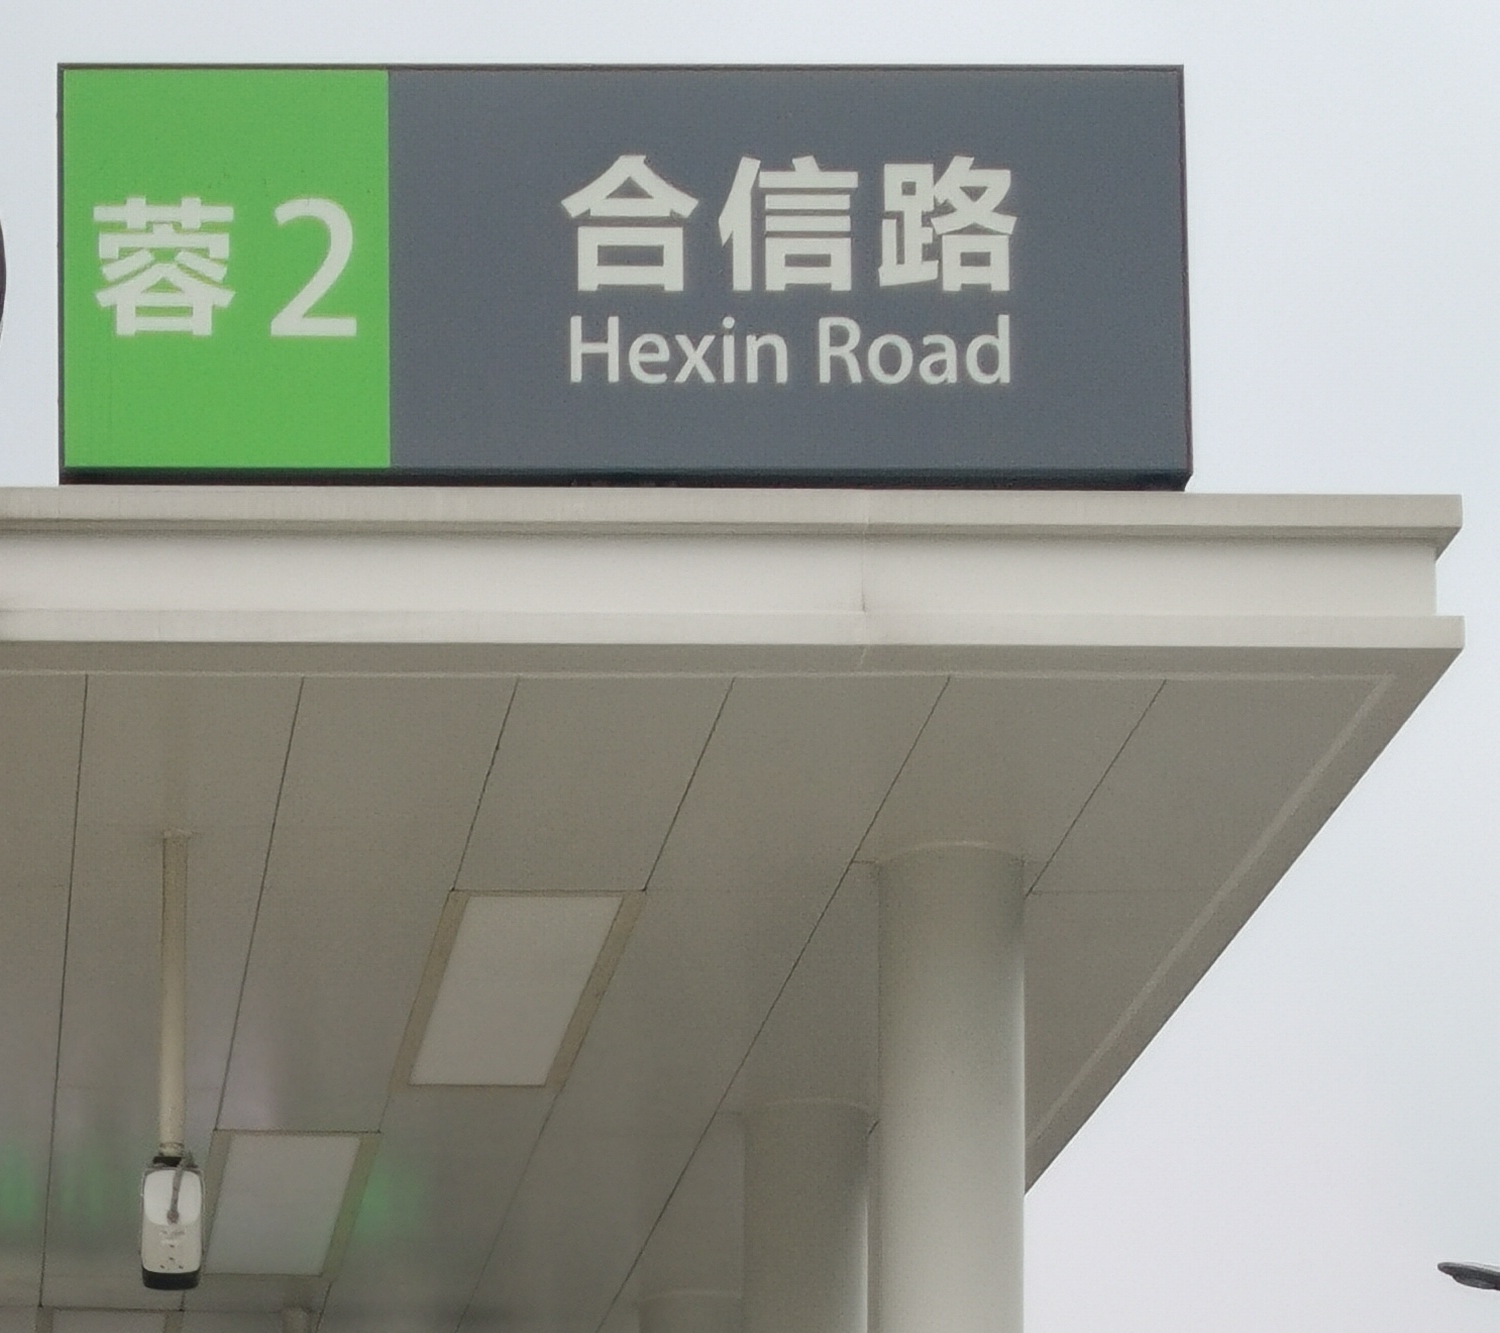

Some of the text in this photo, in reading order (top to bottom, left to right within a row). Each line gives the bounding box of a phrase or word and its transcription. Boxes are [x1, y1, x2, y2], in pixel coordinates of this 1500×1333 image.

[94, 196, 357, 337] 蓉 2
[561, 155, 1017, 291] 合信路
[570, 314, 1011, 384] Hexin Road
